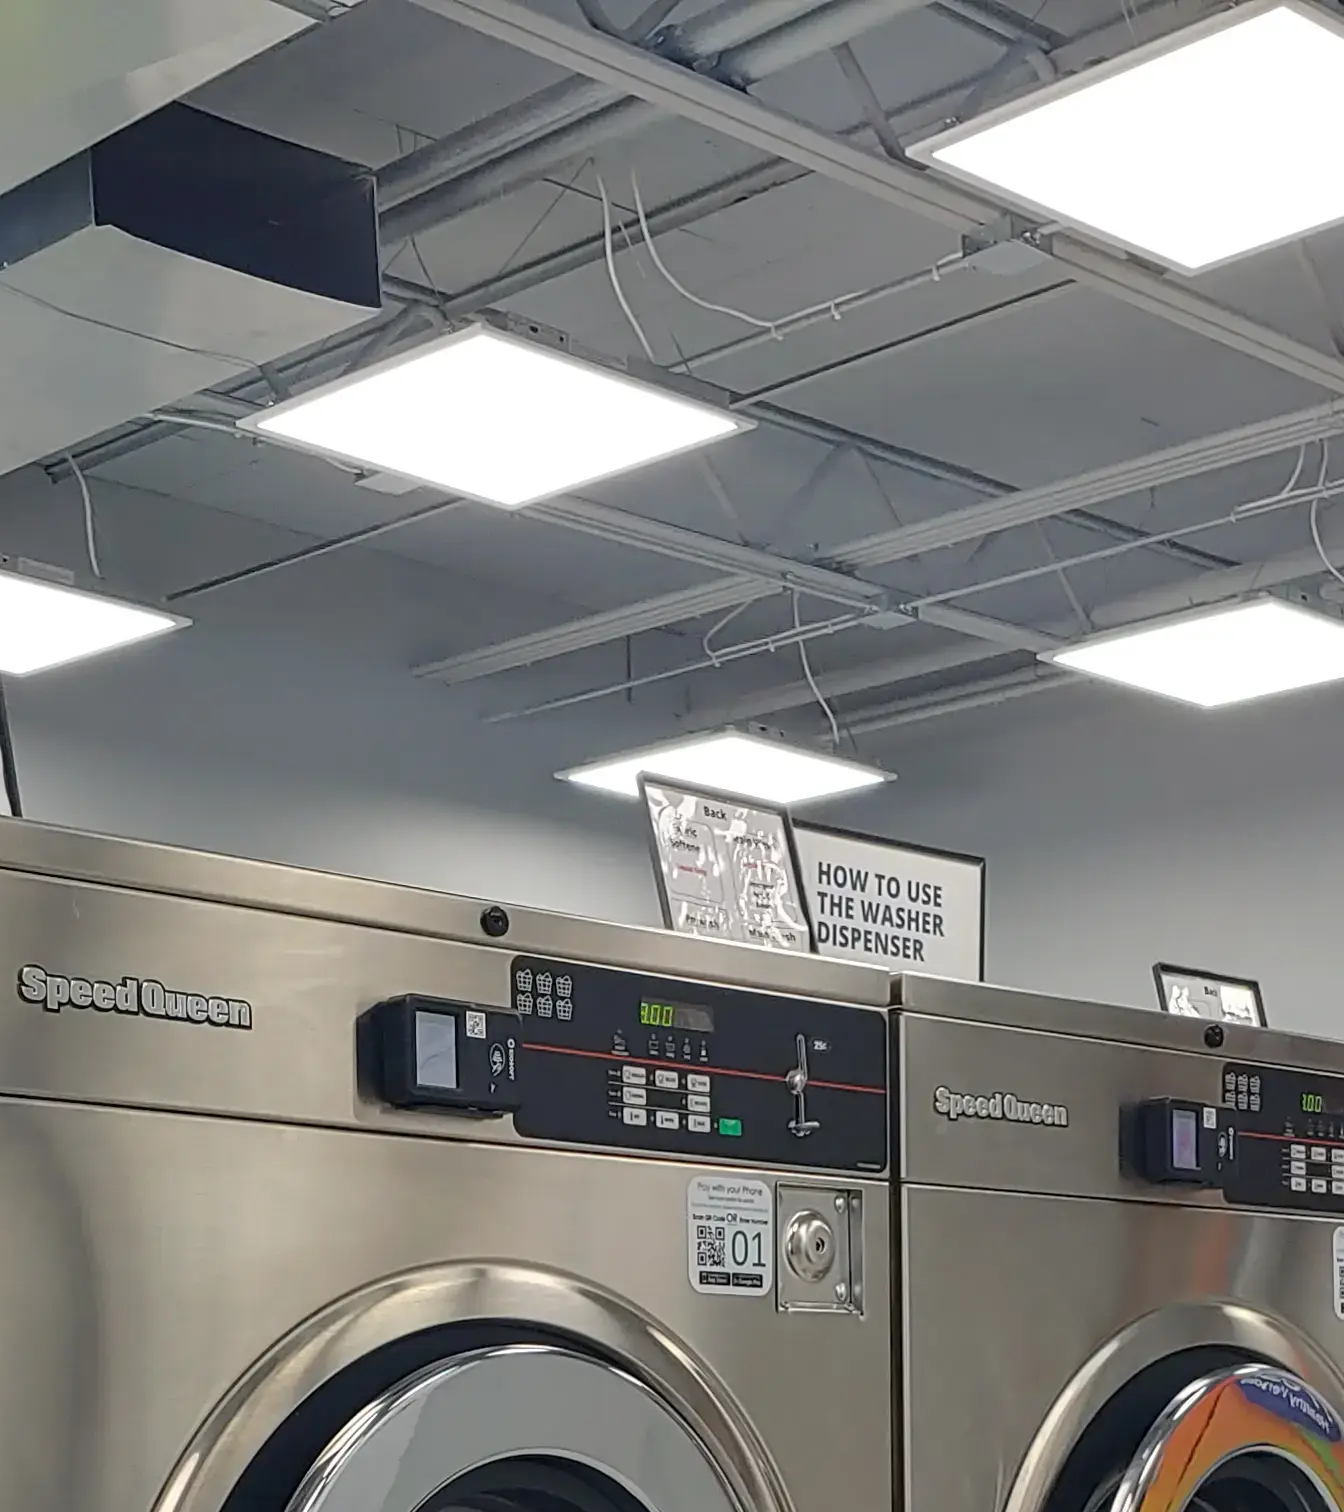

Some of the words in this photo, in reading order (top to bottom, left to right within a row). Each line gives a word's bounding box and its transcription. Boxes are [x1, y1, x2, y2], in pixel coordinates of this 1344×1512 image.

[703, 806, 727, 820] Back
[818, 861, 869, 893] HOW
[875, 873, 901, 899] TO
[907, 879, 943, 909] USE
[817, 890, 855, 920] THE
[860, 900, 945, 937] WASHER
[817, 921, 925, 962] DISPENSER
[18, 964, 139, 1014] Speed
[141, 979, 252, 1029] Queen
[934, 1086, 1002, 1120] Speed
[1003, 1093, 1068, 1127] Queen
[732, 1230, 766, 1267] 01
